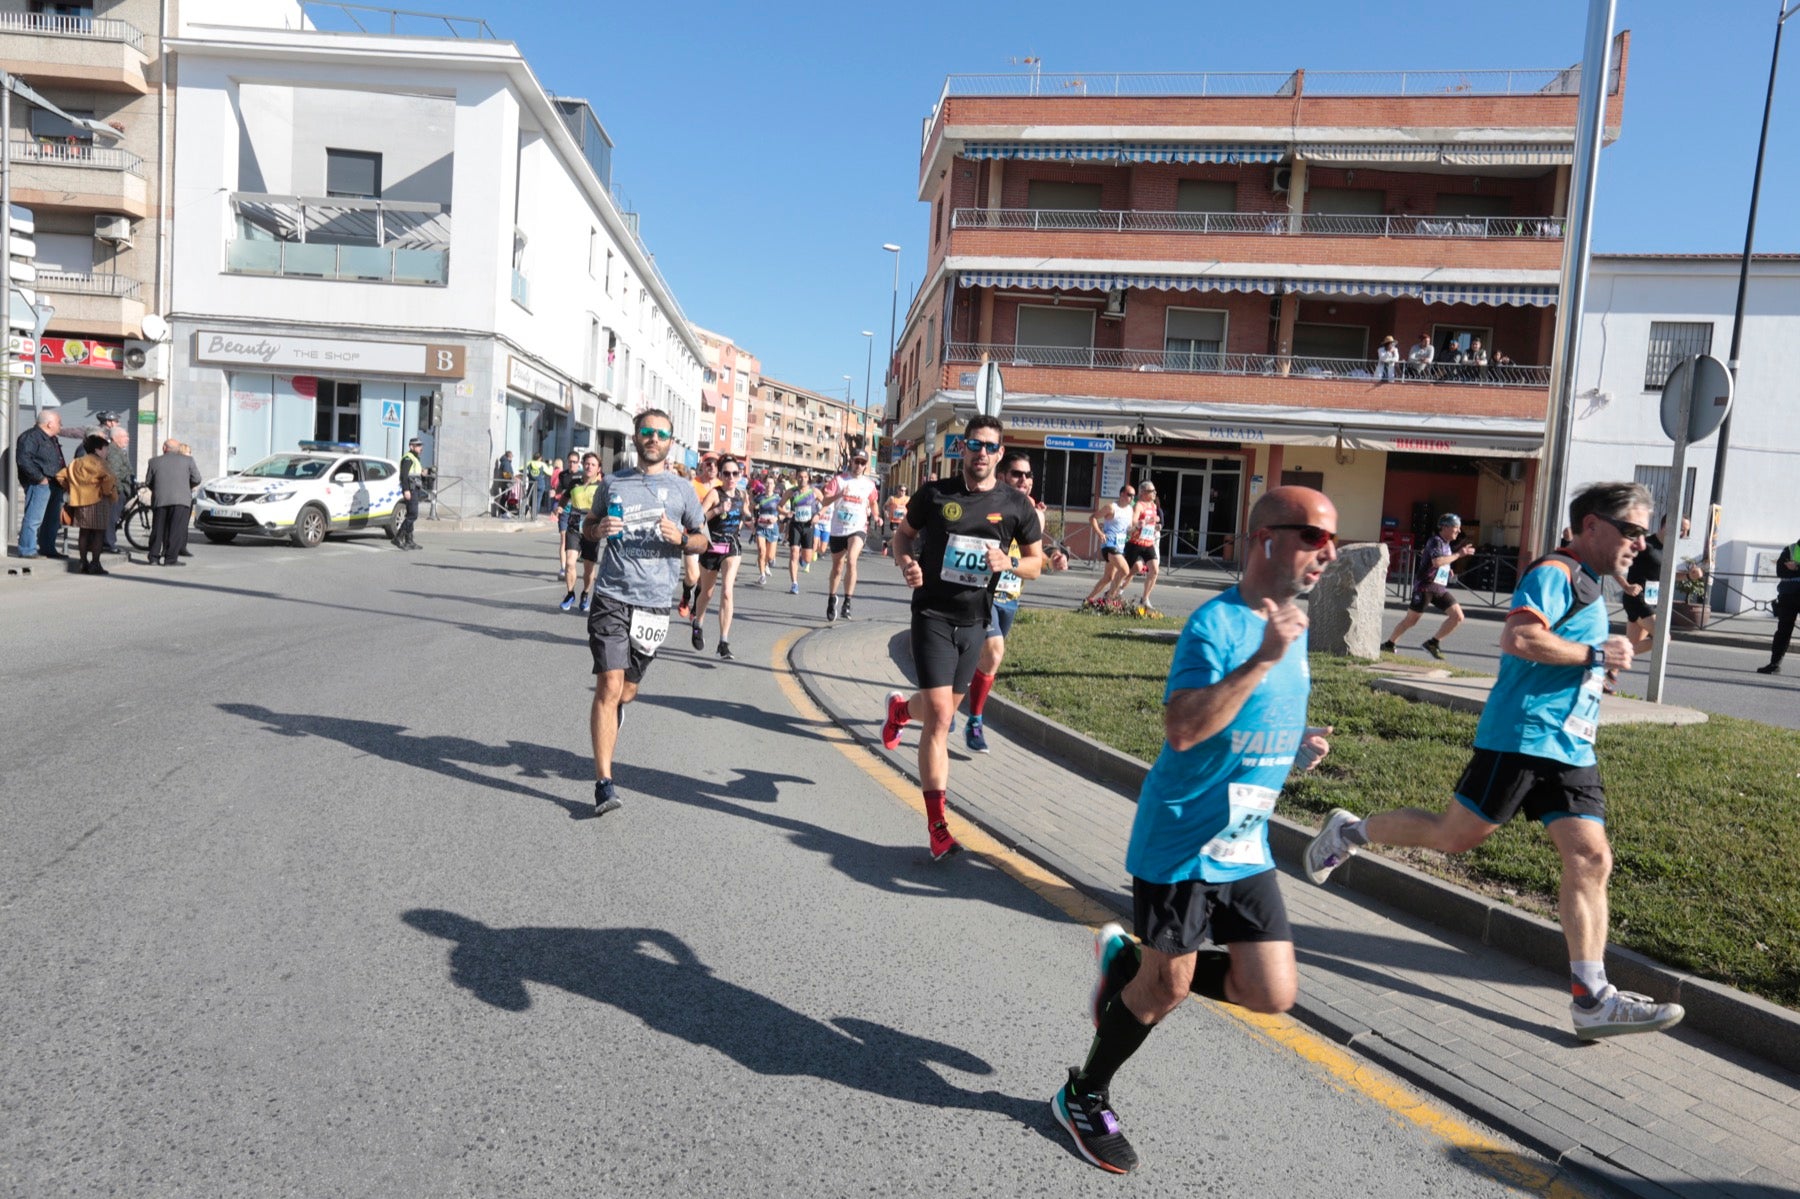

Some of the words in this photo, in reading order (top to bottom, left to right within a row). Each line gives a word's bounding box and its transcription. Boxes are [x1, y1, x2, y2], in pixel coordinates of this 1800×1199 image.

[208, 336, 281, 362] Beauty
[293, 349, 318, 359] THE
[324, 351, 360, 362] SHOP
[436, 350, 454, 371] B
[1011, 416, 1104, 431] RESTAURANTE
[1209, 426, 1265, 440] PARADA
[1046, 438, 1075, 447] Granada
[954, 551, 988, 572] 705
[635, 625, 666, 642] 3066
